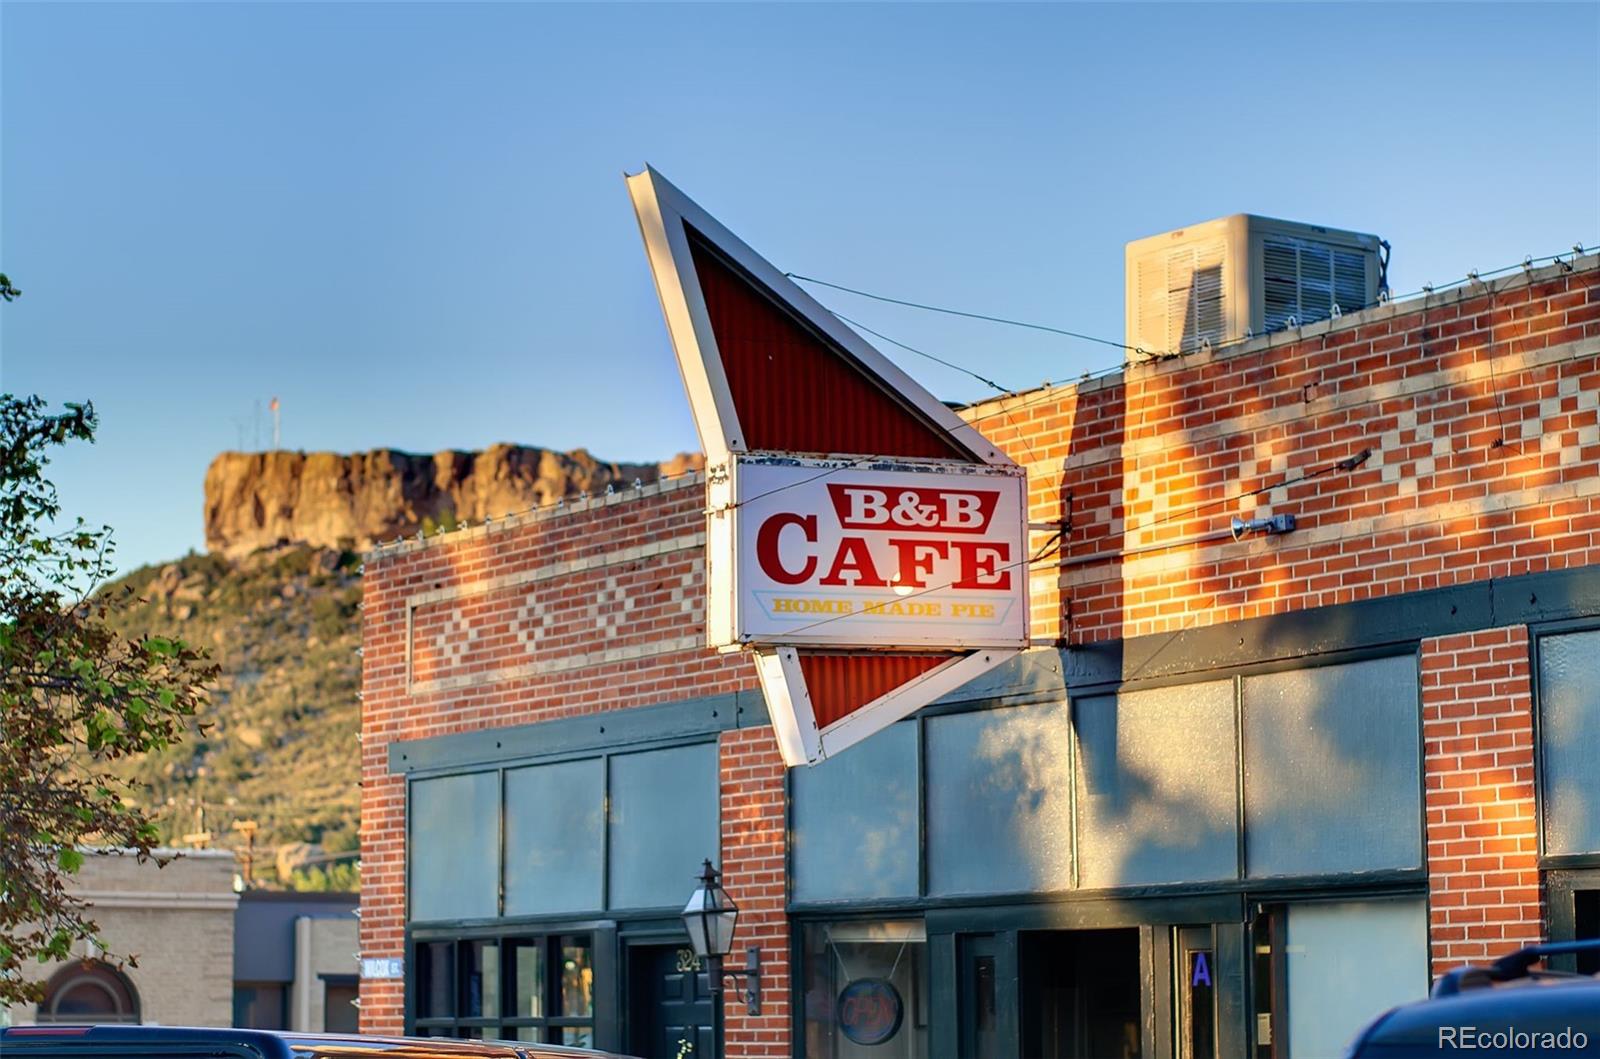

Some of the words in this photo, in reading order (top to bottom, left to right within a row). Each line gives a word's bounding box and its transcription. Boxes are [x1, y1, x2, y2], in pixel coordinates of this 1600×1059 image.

[844, 488, 985, 528] B&B
[756, 512, 1011, 591] CAFE
[772, 598, 853, 615] HOME
[863, 601, 941, 617] MADE
[951, 604, 996, 618] PIE
[676, 949, 701, 972] 324
[1192, 952, 1212, 987] A
